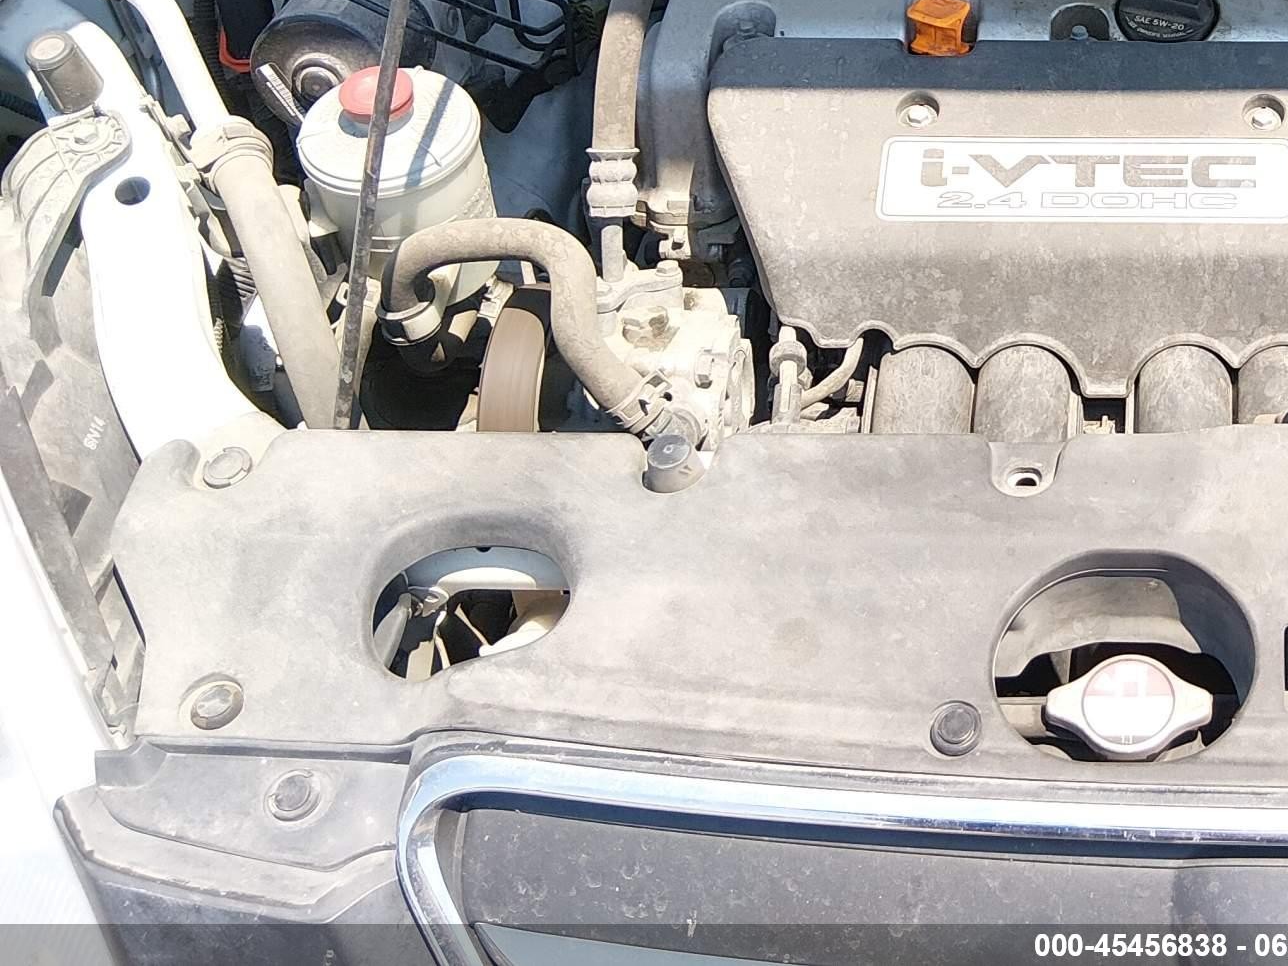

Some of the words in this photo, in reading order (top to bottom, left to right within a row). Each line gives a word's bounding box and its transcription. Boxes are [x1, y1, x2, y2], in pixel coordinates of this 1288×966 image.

[1134, 15, 1151, 24] SAE
[1152, 18, 1185, 31] 5W-20
[920, 148, 1257, 188] i-VTEC
[936, 191, 1028, 209] 2.4
[1040, 192, 1238, 210] DOHC
